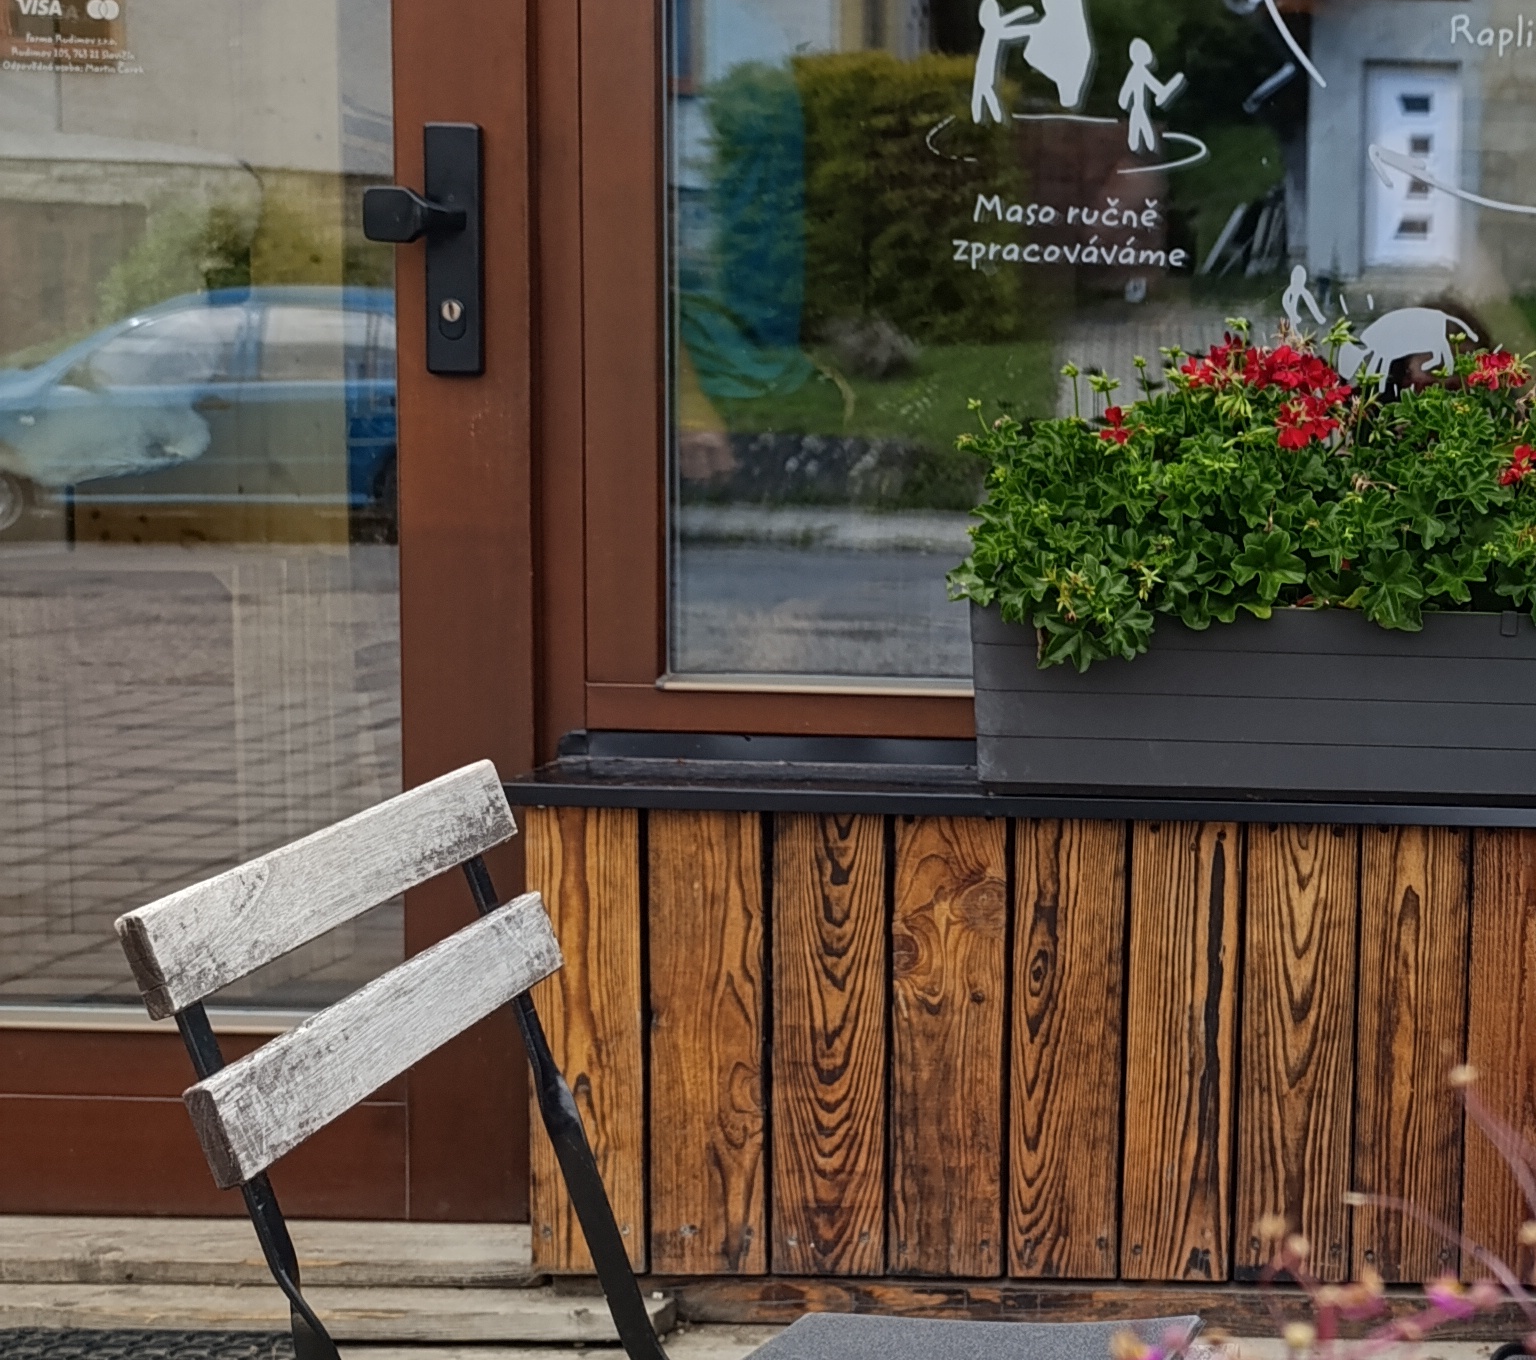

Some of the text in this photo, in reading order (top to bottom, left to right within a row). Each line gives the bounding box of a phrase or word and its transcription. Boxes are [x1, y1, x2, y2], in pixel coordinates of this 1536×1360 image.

[1449, 14, 1534, 57] Rapli
[973, 193, 1158, 228] Maso ručně
[952, 234, 1187, 271] zpracováváme
